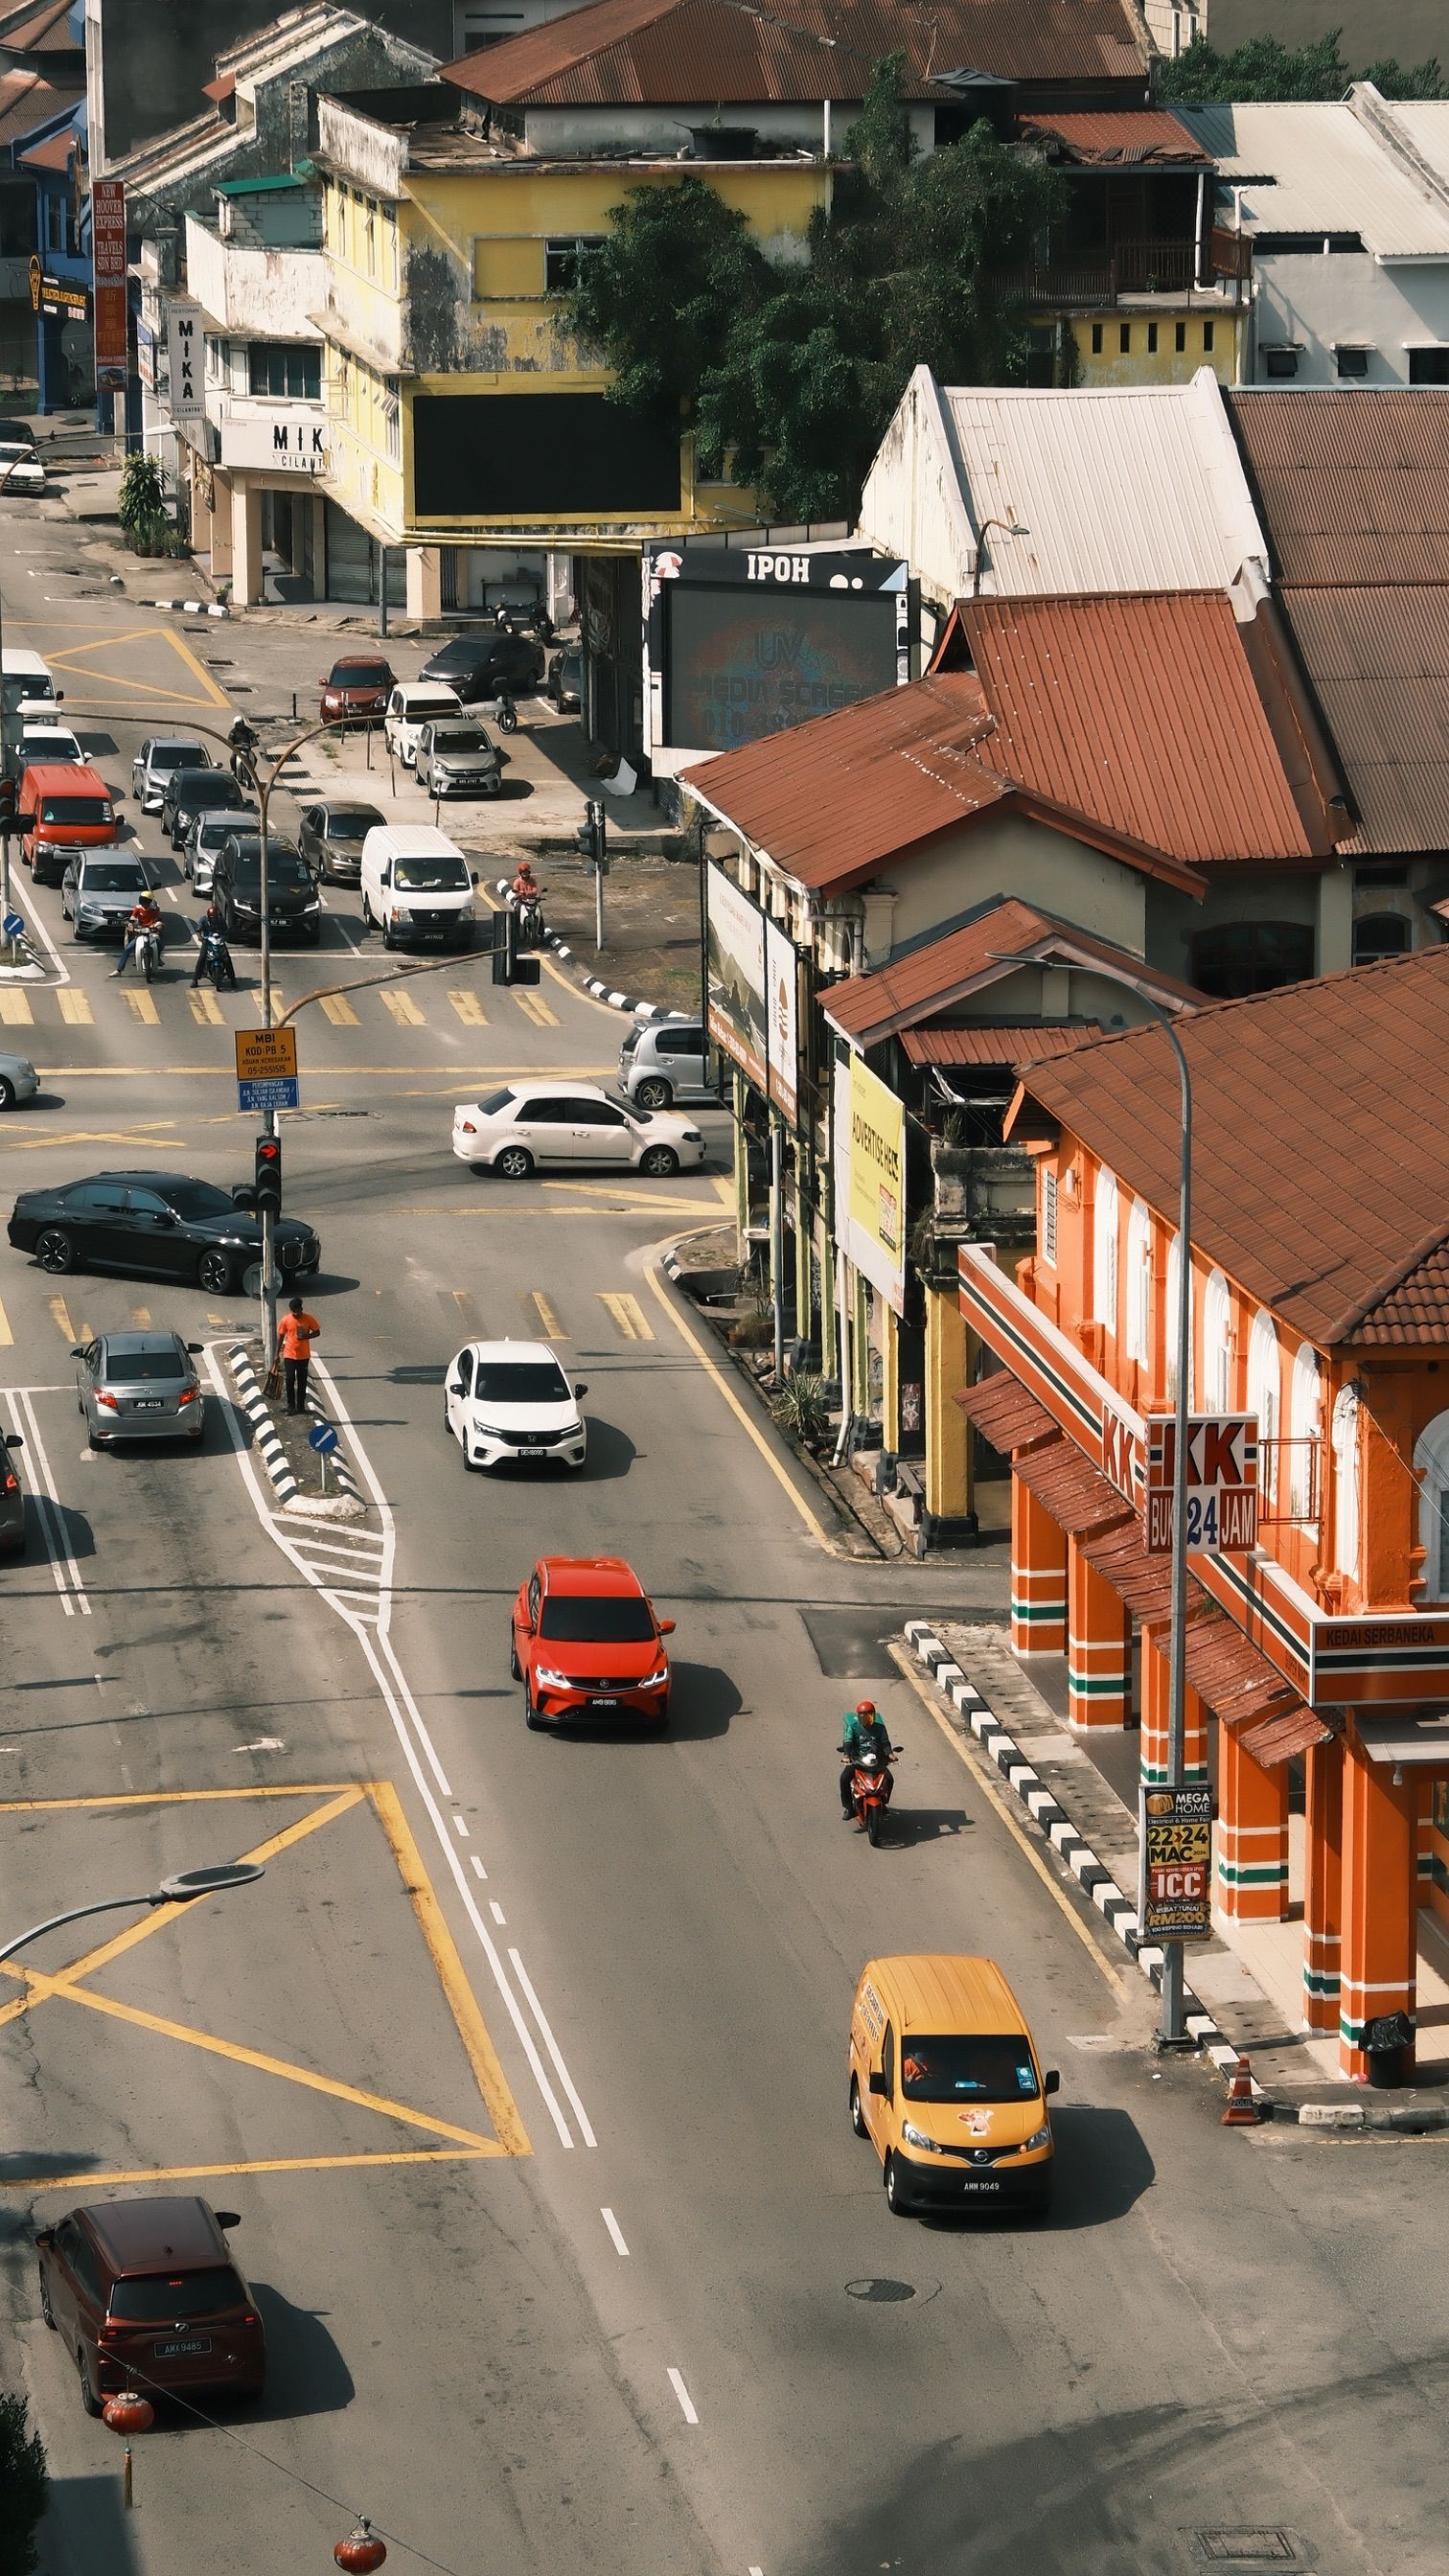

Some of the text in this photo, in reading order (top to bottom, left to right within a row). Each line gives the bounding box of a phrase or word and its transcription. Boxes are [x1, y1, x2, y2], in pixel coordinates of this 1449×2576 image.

[102, 184, 116, 197] NEW
[96, 199, 123, 214] HOOVER
[96, 216, 124, 229] EXPRESS
[106, 230, 112, 240] &
[96, 241, 124, 255] TRAVELS
[97, 256, 124, 270] SDN BHD
[178, 320, 194, 399] MIKA
[747, 554, 810, 583] IPOH
[692, 676, 874, 708] MEDIA SCREE
[255, 1033, 275, 1044] MBI
[852, 1111, 884, 1168] ADVERTISE
[1103, 1405, 1135, 1503] KK
[1163, 1422, 1245, 1486] KK
[1187, 1495, 1218, 1545] 24
[1221, 1495, 1254, 1545] JAM
[1326, 1624, 1435, 1645] KEDAI SERBANEKA
[1175, 1792, 1210, 1804] MEGA
[1175, 1803, 1210, 1813] HOME
[1149, 1826, 1208, 1846] 22 24
[1150, 1846, 1193, 1864] MAC
[1158, 1872, 1201, 1898] ICC
[1149, 1911, 1206, 1926] RM200
[979, 2182, 1000, 2191] 9049
